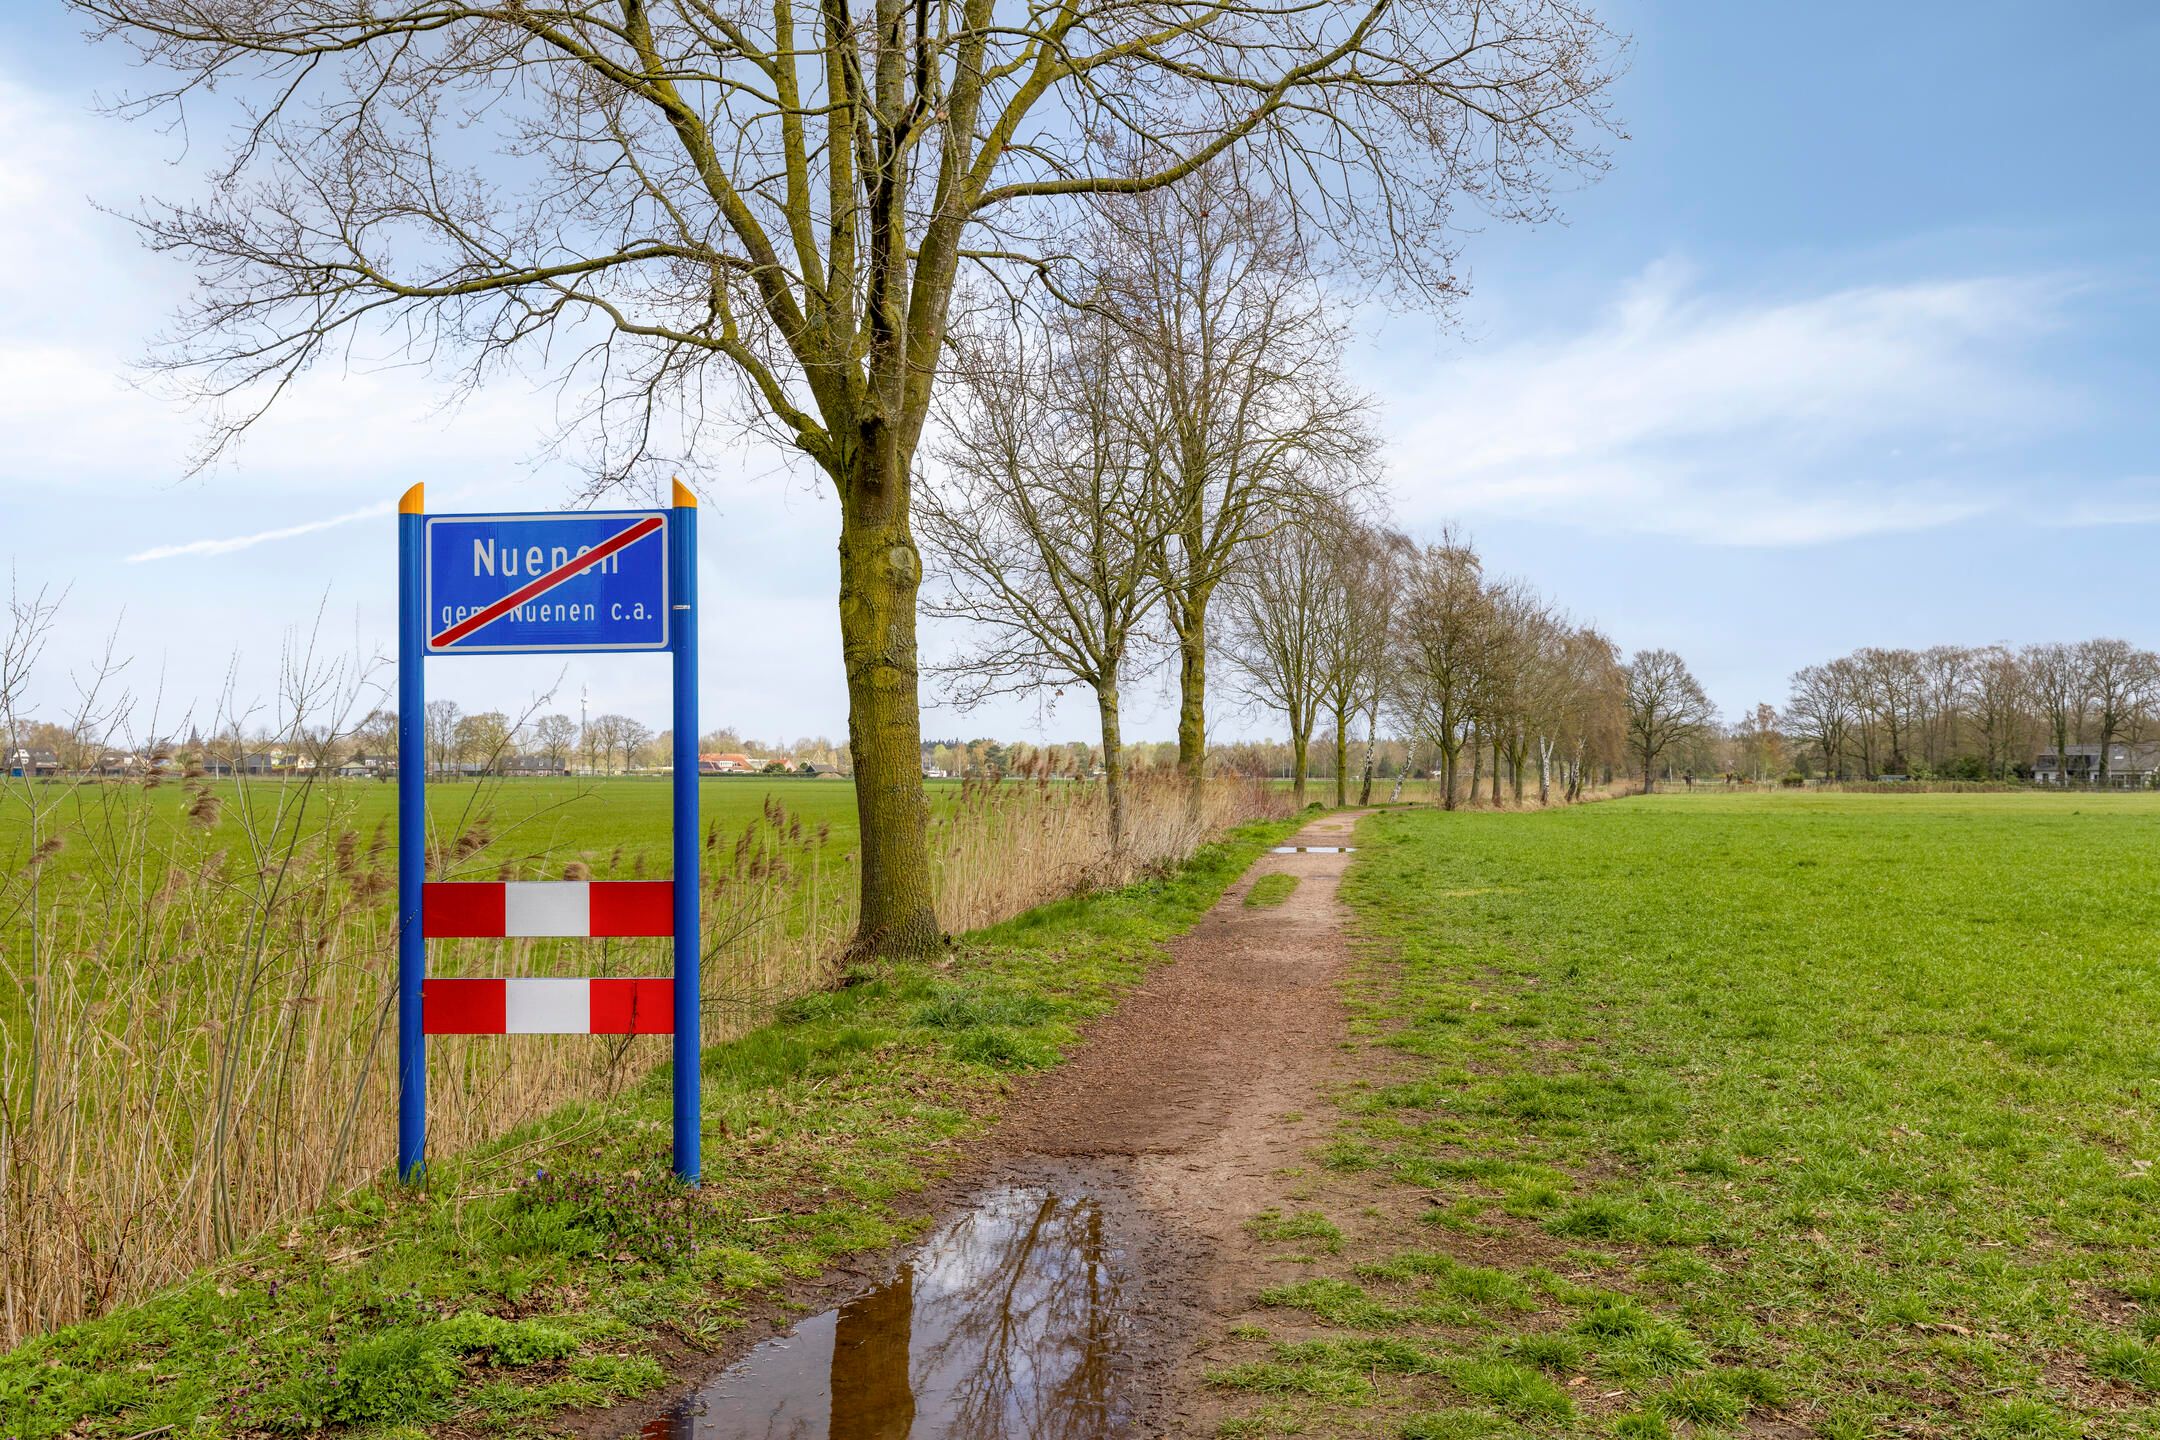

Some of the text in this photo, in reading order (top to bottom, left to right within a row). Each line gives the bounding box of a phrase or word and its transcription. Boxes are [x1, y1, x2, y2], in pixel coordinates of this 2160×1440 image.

[473, 538, 618, 577] Nuenen
[510, 602, 595, 622] Nuenen
[611, 602, 653, 621] c.a.
